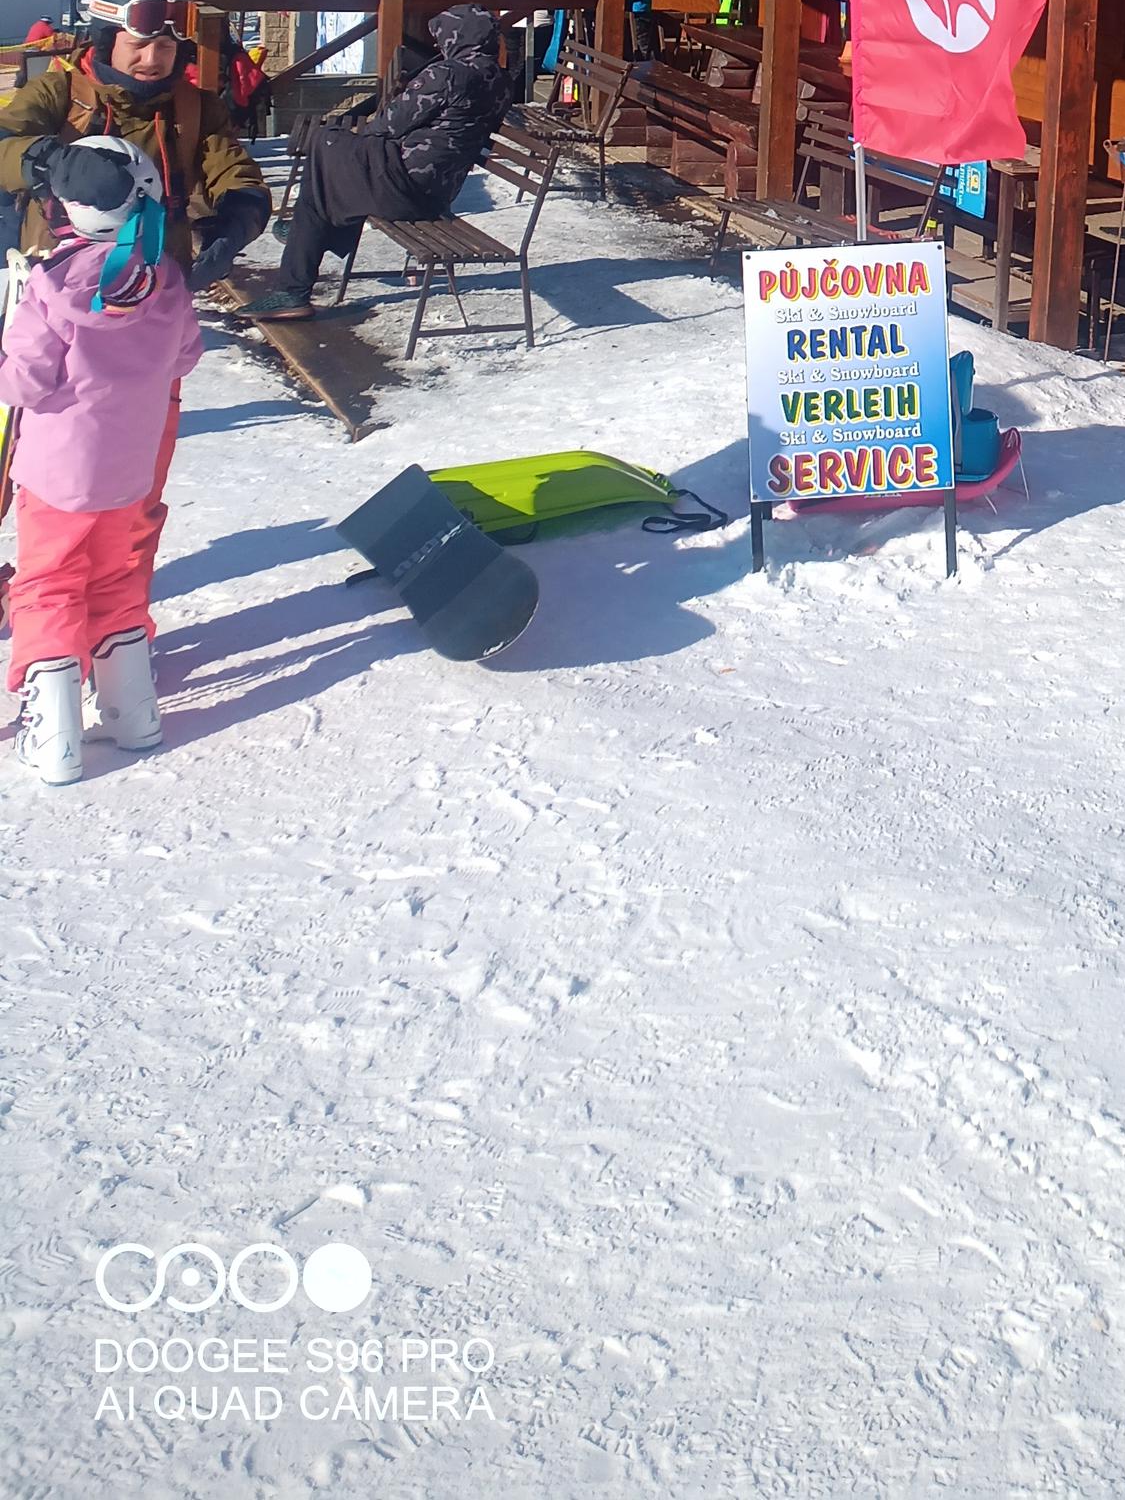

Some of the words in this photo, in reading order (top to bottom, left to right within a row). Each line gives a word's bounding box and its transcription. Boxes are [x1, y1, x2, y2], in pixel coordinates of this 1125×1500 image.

[758, 259, 931, 300] PŮJČOVNA
[776, 308, 802, 323] Ski
[809, 308, 824, 321] &
[829, 301, 917, 319] Snowboard
[787, 324, 907, 361] RENTAL
[777, 370, 805, 384] Ski
[811, 369, 826, 382] &
[830, 362, 920, 381] Snowboard
[781, 384, 918, 425] VERLEIH
[780, 431, 807, 446] Ski
[812, 430, 828, 443] &
[832, 423, 922, 443] Snowboard
[768, 446, 937, 494] SERVICE
